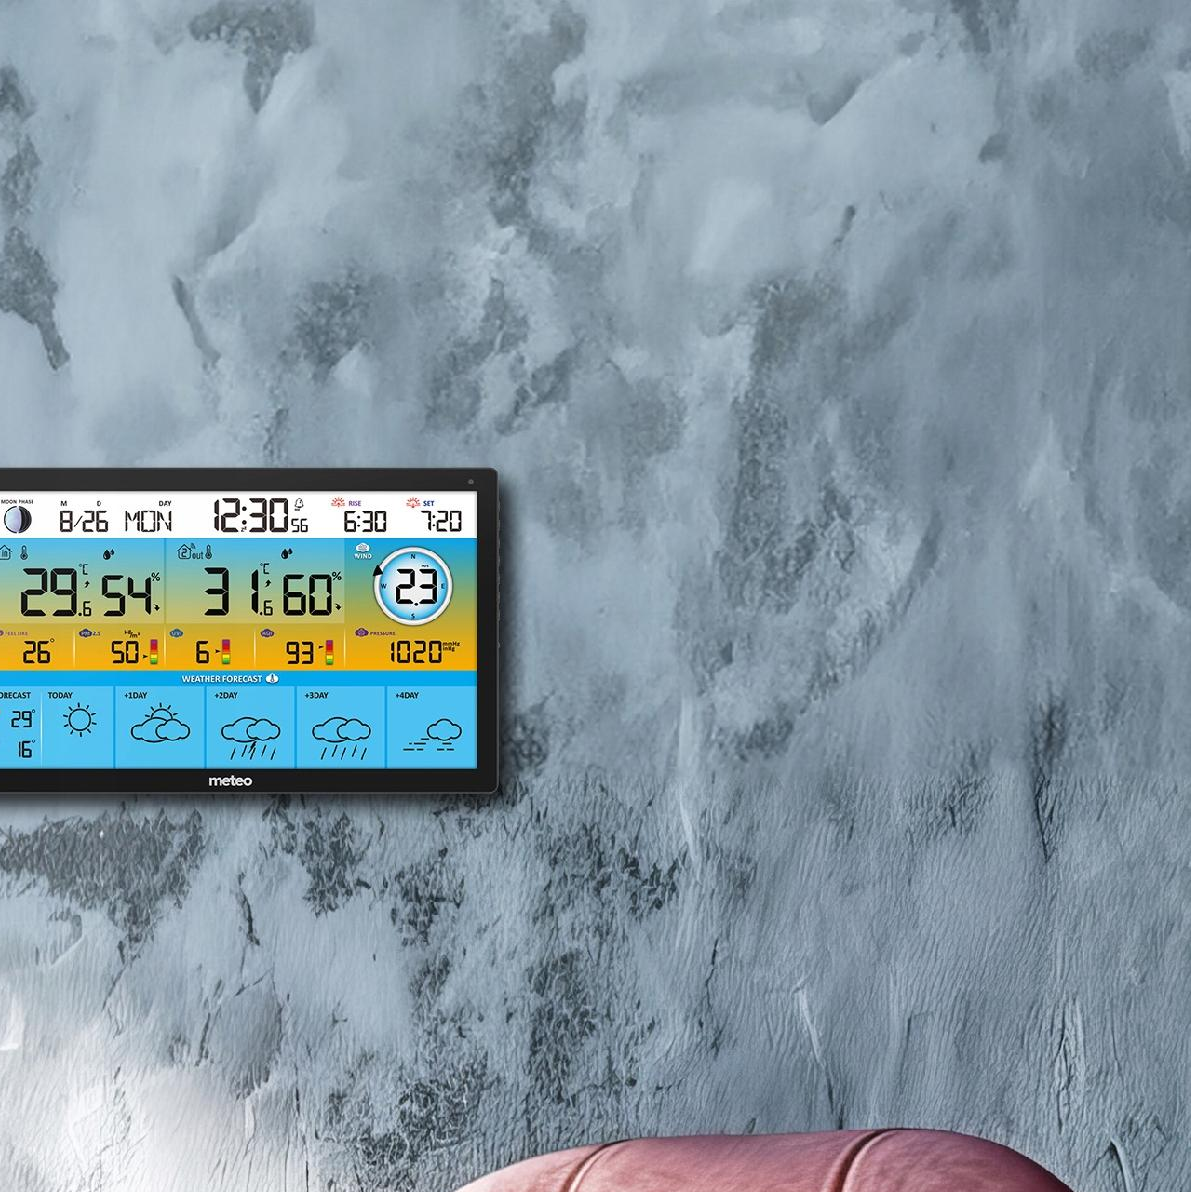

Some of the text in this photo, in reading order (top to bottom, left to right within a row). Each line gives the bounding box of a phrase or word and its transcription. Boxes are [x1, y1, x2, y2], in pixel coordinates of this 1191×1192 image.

[60, 510, 109, 533] 8/26
[125, 510, 172, 533] MON
[214, 498, 289, 532] 12:30
[291, 518, 308, 533] 56
[344, 510, 387, 533] 6:30
[421, 510, 462, 533] 7:20
[192, 551, 204, 560] out
[111, 640, 139, 664] 50
[196, 640, 209, 664] 6
[286, 641, 314, 665] 93
[391, 640, 442, 664] 1020
[181, 675, 263, 683] WEATHER FORECAST
[48, 691, 74, 699] TODAY
[208, 774, 253, 787] meteo
